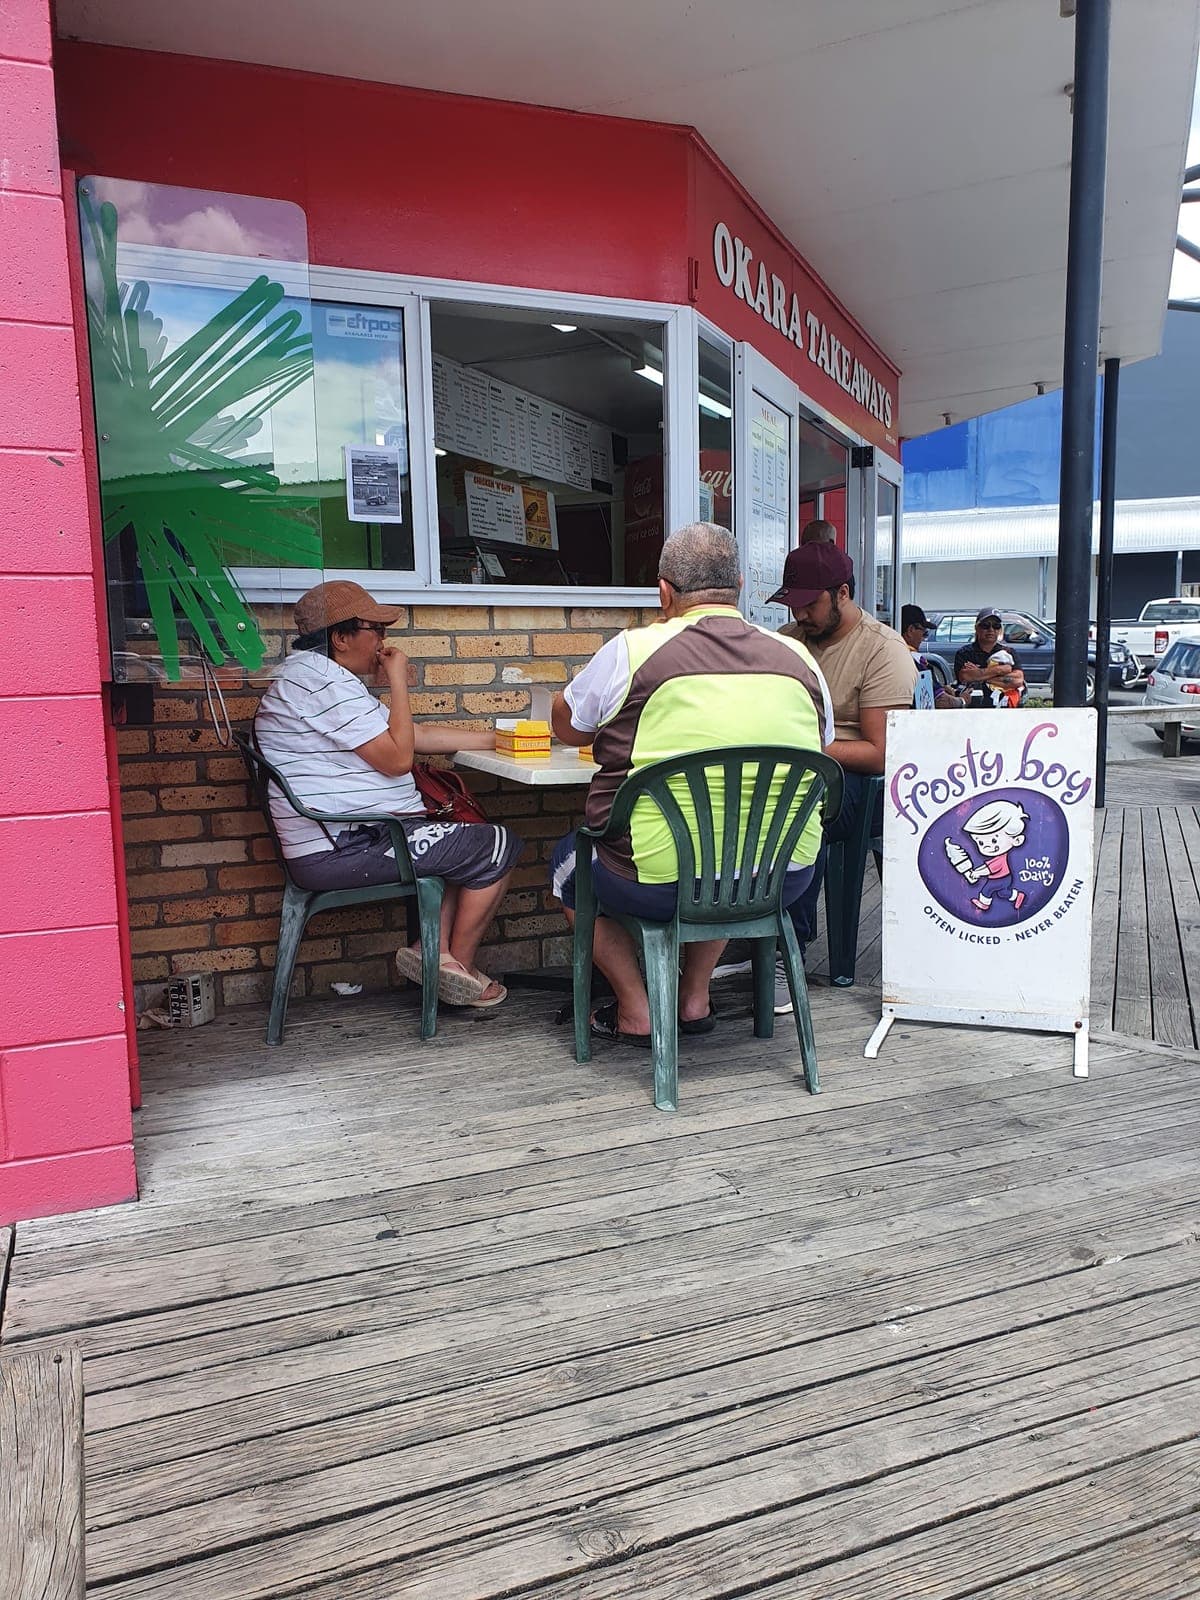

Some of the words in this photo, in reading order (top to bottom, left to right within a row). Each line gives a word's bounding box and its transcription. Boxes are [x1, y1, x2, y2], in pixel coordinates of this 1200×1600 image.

[346, 313, 401, 332] eftpos
[713, 222, 804, 349] OKARA
[806, 310, 892, 429] TAKEAWAYS
[890, 738, 1003, 835] frosty
[1015, 722, 1092, 805] boy
[1018, 869, 1055, 886] Dairy
[1024, 856, 1051, 870] 100%
[923, 905, 955, 935] OFTEN
[958, 932, 1001, 945] LICKED
[1015, 919, 1054, 942] NEVER
[1053, 878, 1084, 920] BEATEN
